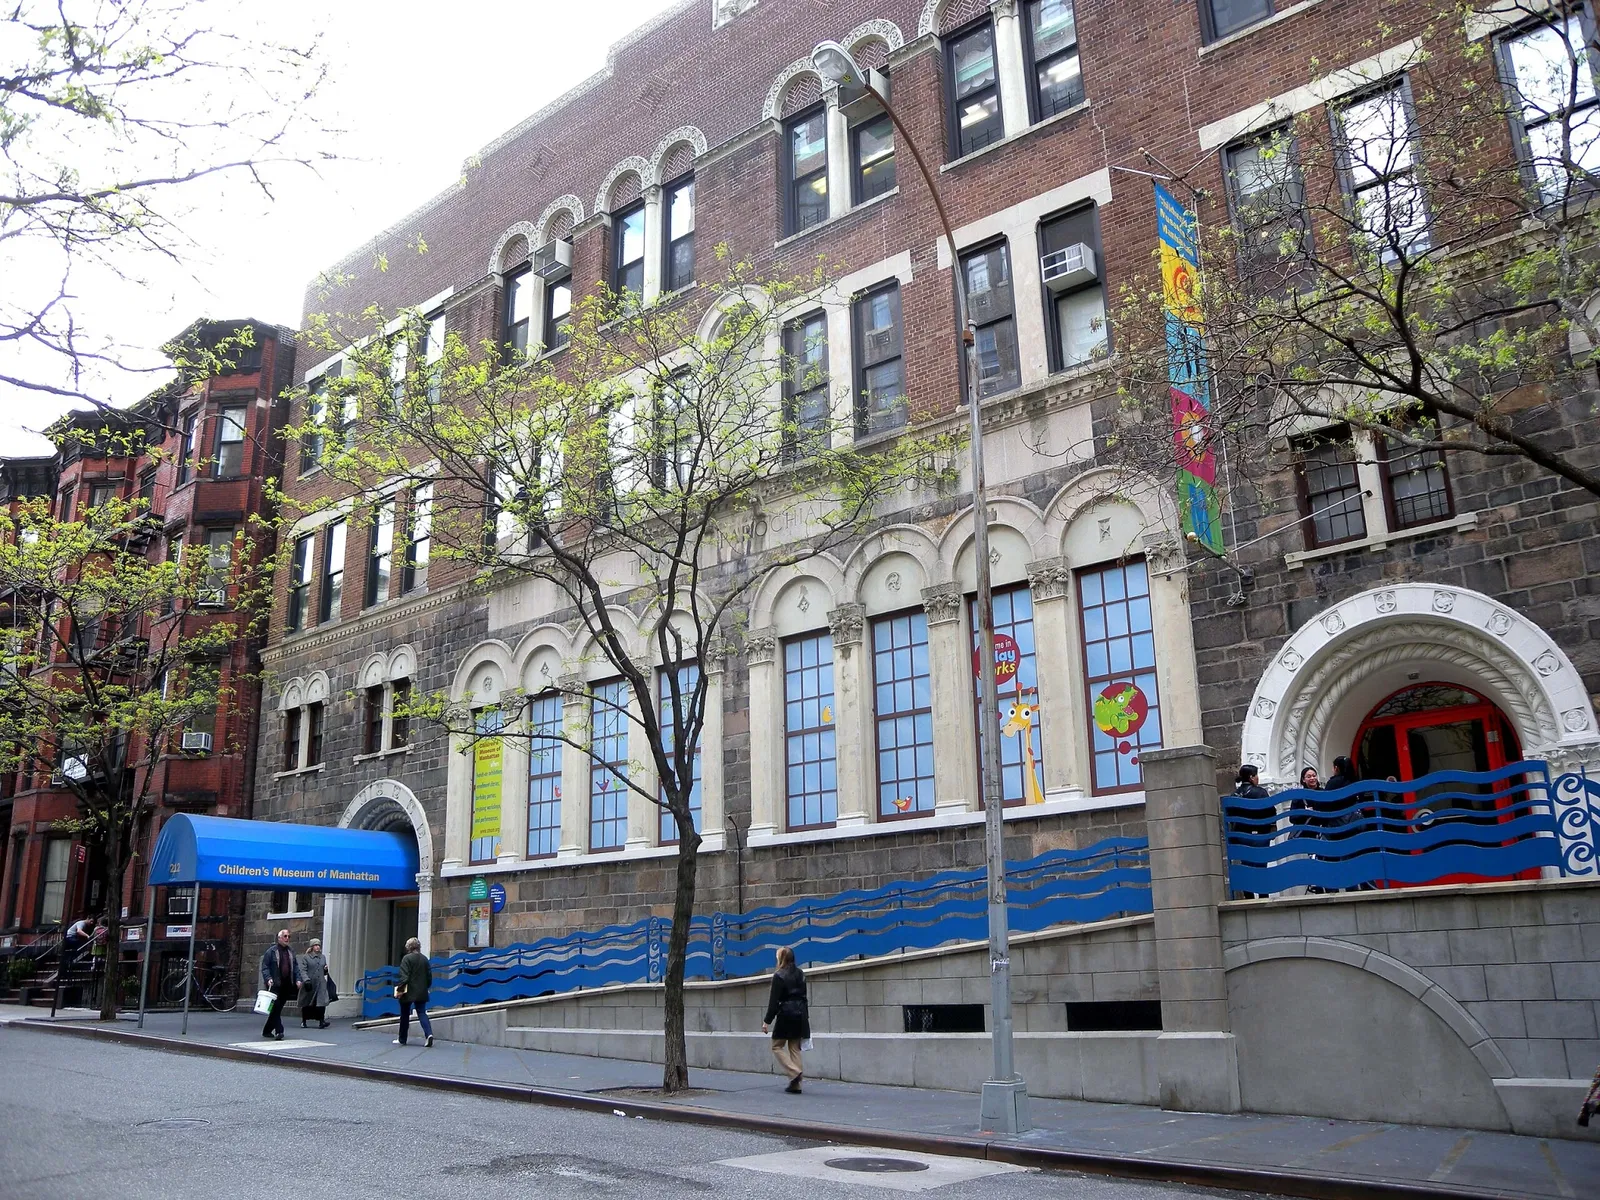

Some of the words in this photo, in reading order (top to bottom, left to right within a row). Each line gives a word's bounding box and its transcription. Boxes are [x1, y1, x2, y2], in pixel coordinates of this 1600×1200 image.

[1005, 639, 1011, 648] in
[994, 650, 1015, 662] lay
[218, 863, 270, 877] Children's
[272, 867, 315, 878] Museum
[317, 869, 328, 879] of
[329, 869, 380, 882] Manhattan
